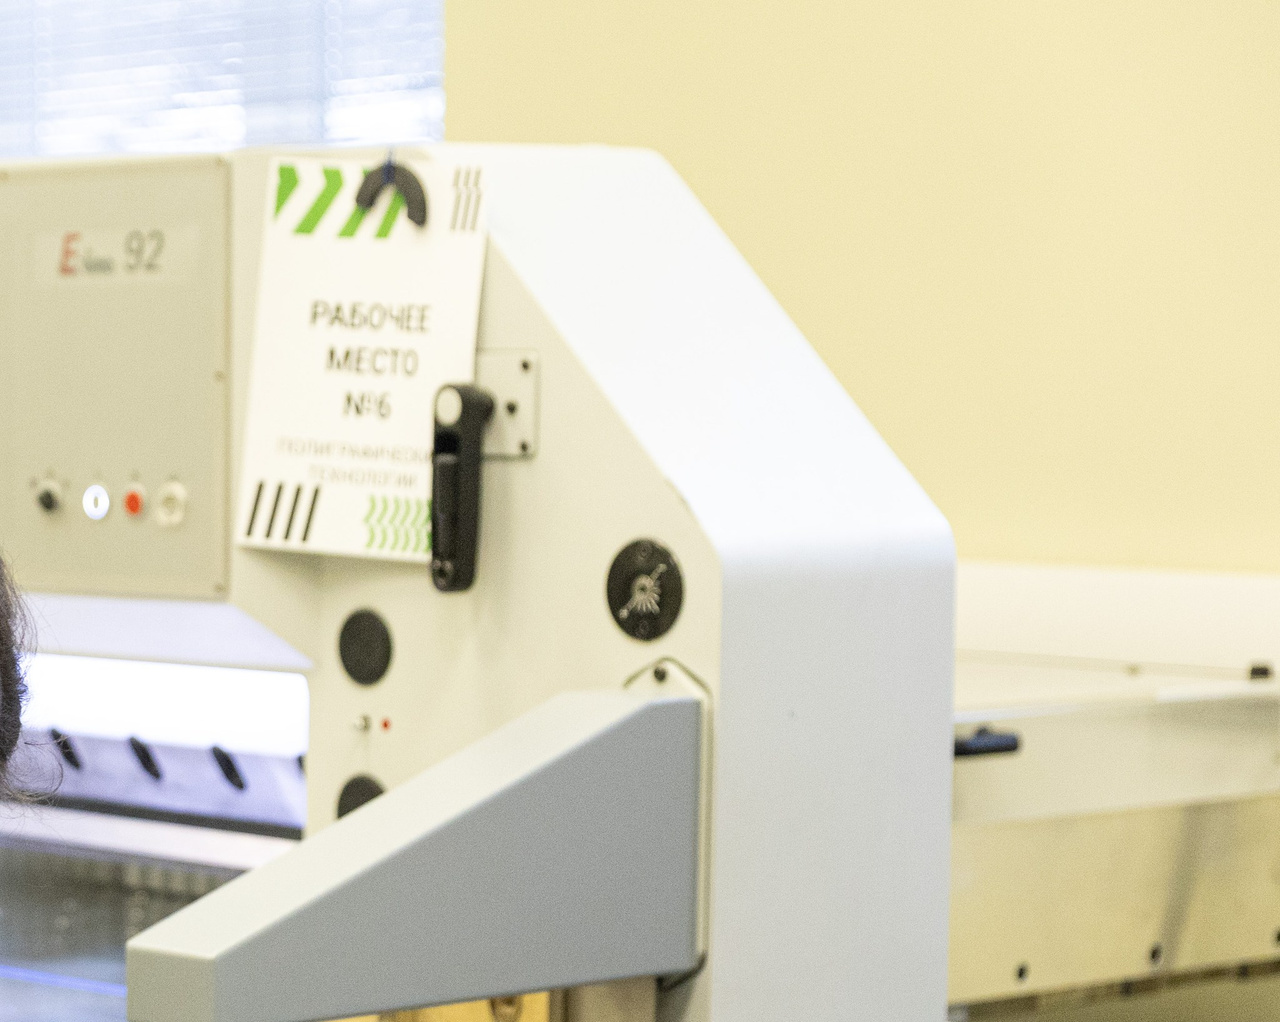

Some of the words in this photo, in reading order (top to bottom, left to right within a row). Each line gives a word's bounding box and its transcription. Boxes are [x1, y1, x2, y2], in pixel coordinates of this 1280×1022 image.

[124, 228, 166, 272] 92
[310, 300, 429, 333] РАБОЧЕЕ
[326, 346, 419, 376] МЕСТО
[343, 391, 391, 419] №6
